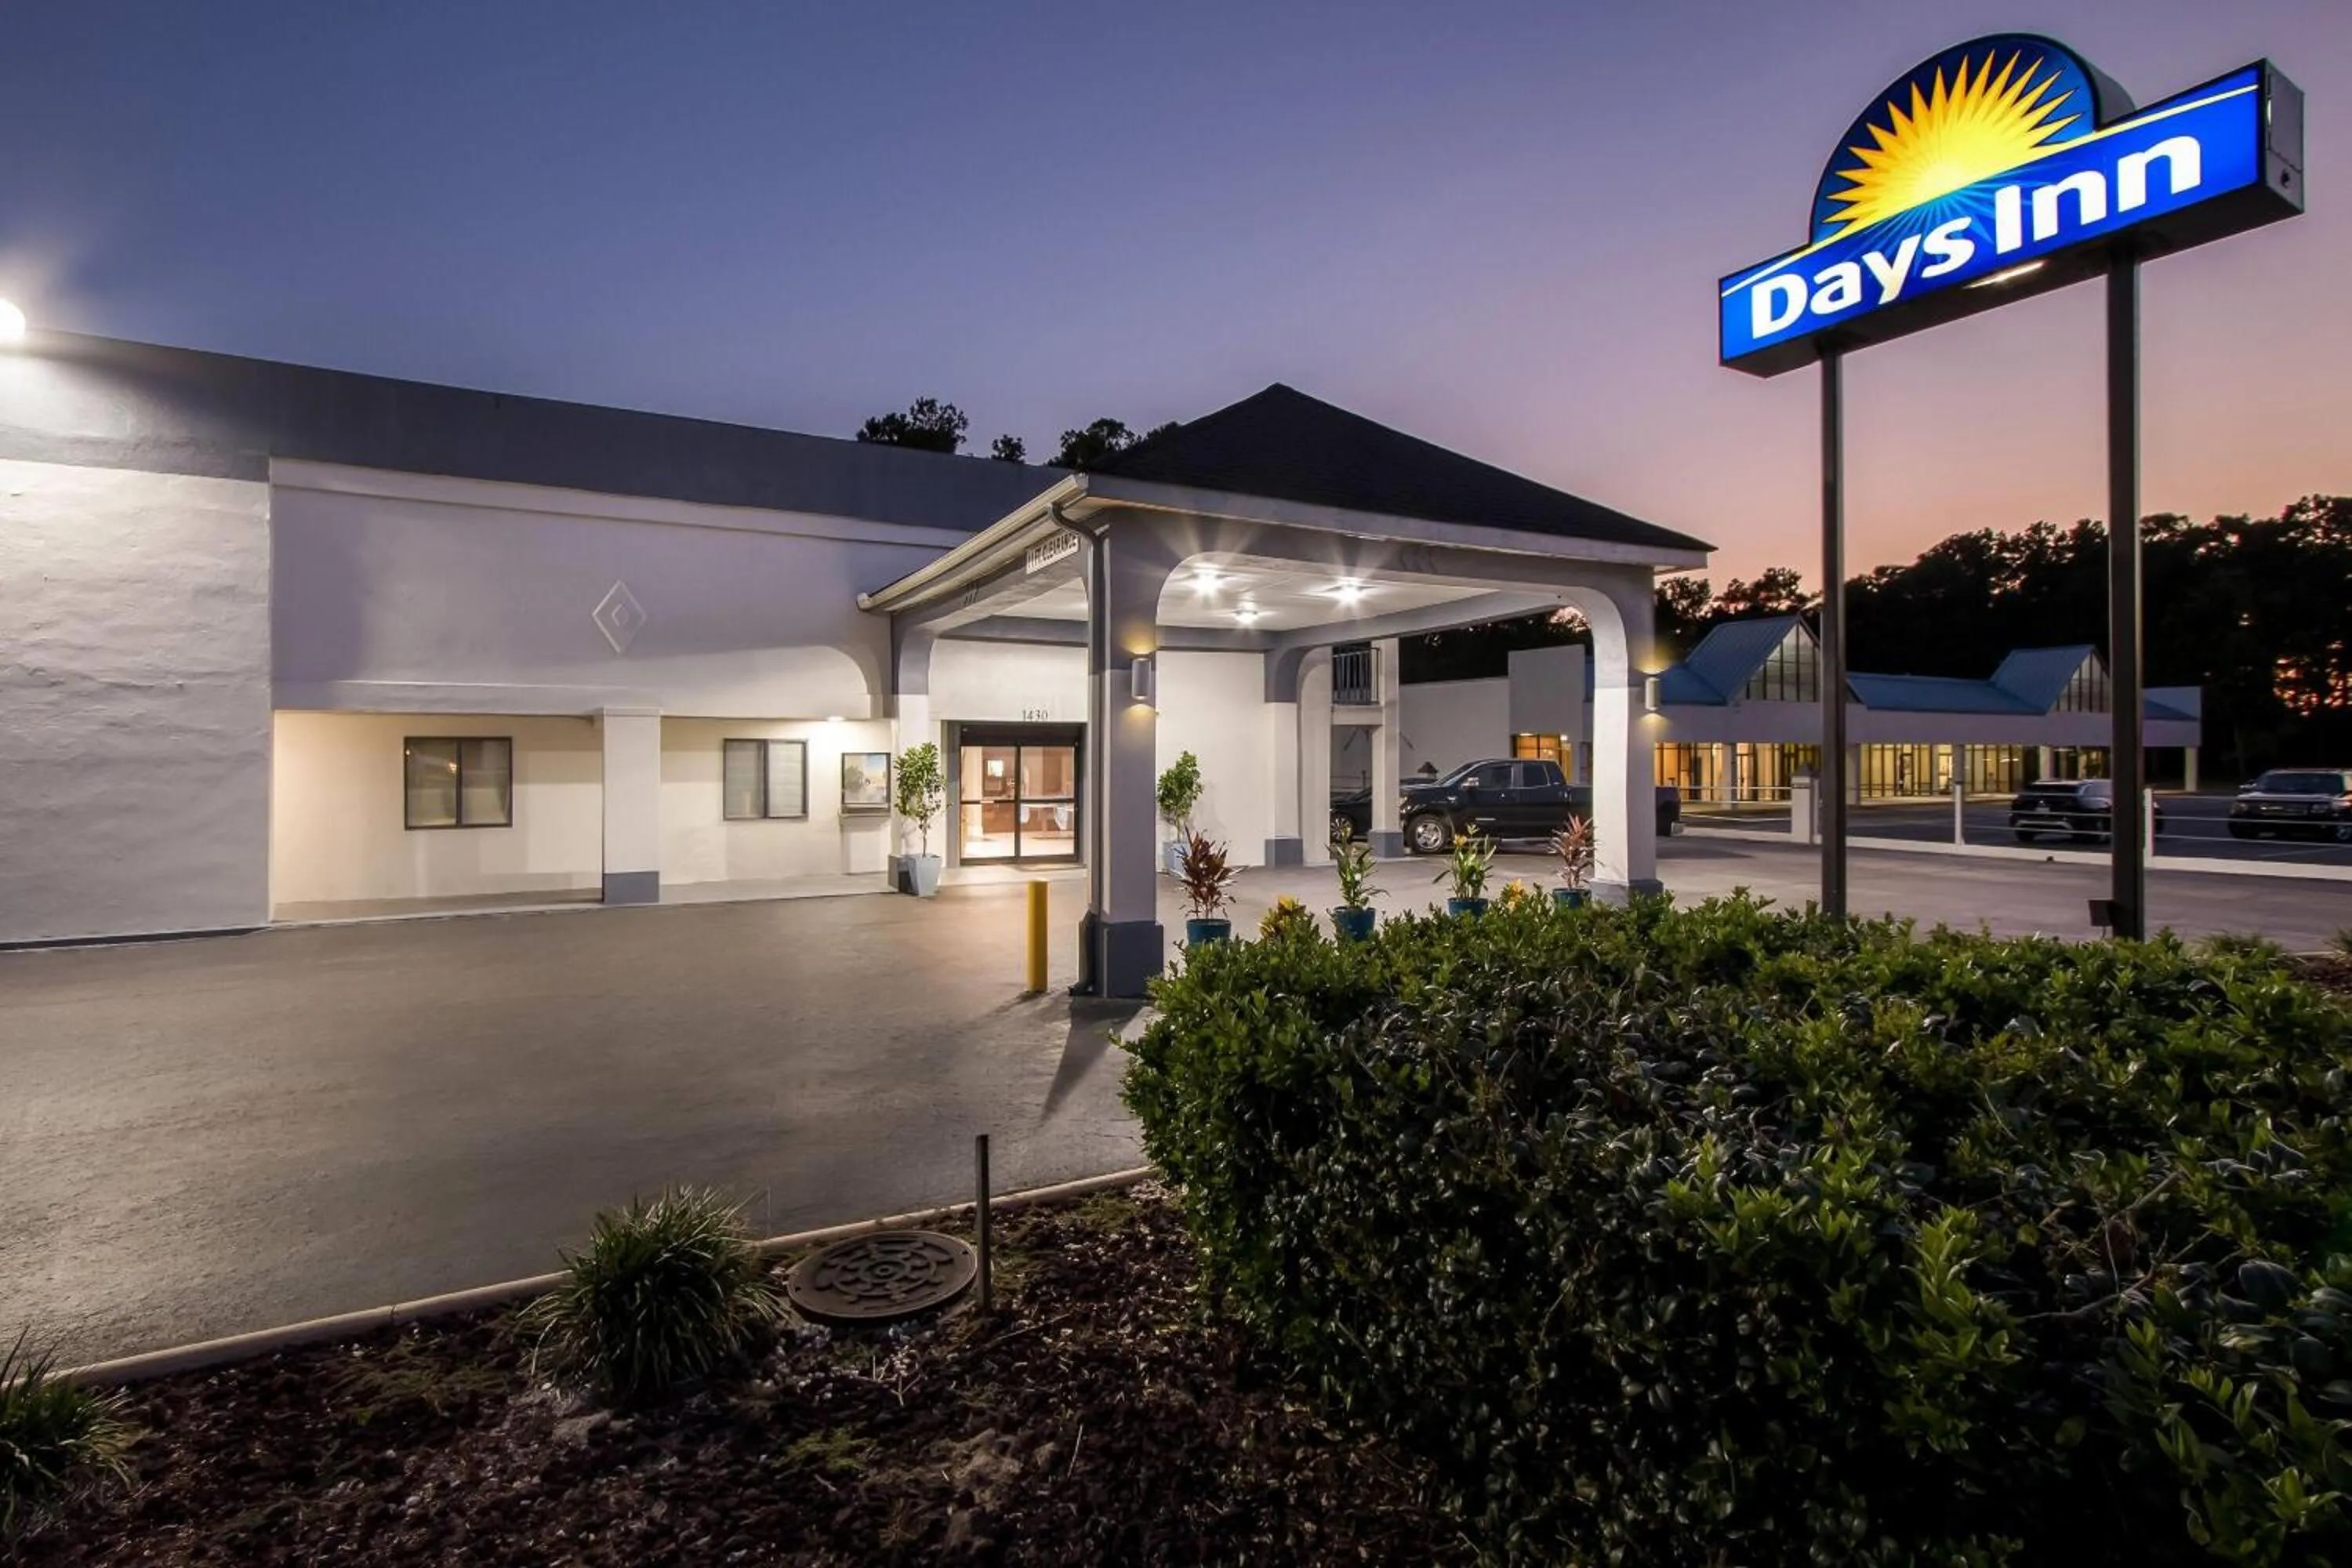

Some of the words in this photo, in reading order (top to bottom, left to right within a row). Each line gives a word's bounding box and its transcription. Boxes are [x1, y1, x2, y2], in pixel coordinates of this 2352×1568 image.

[1751, 216, 1976, 339] Days
[1994, 135, 2201, 255] Inn
[1022, 709, 1048, 721] 1430
